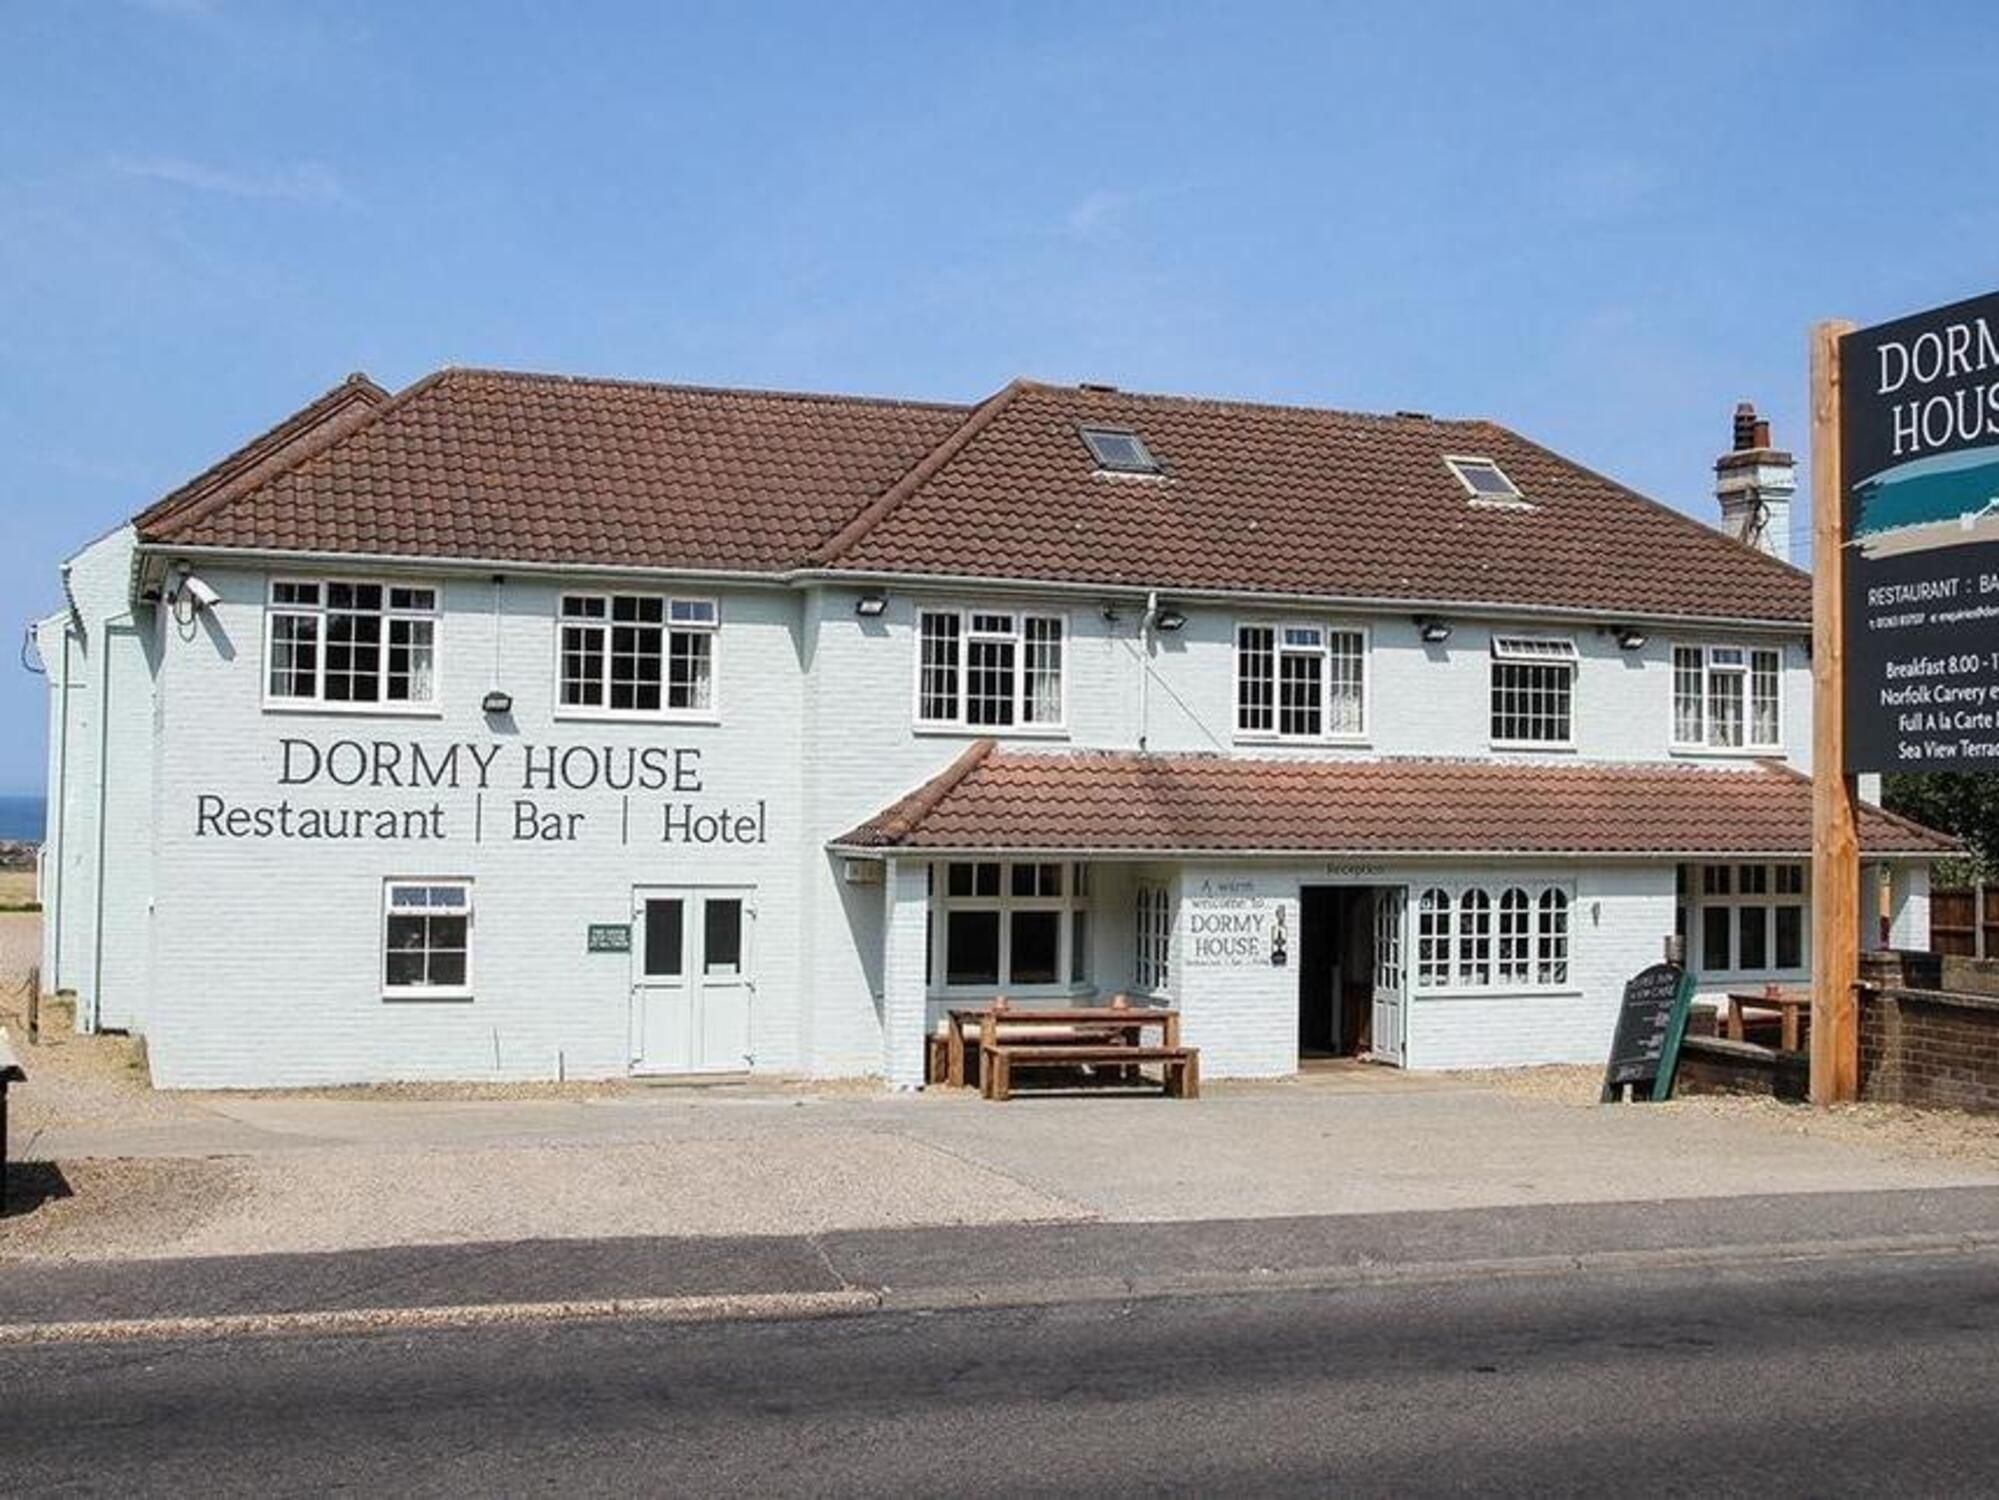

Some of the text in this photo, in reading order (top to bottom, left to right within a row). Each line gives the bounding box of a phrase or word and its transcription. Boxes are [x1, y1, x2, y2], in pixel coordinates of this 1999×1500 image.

[1868, 578, 1960, 606] RESTAURANT
[1886, 656, 1946, 679] Breakfast
[1948, 655, 1979, 674] 8.00
[1881, 685, 1931, 707] Norfolk
[1934, 684, 1986, 706] Carvery
[1899, 712, 1922, 732] Full
[1926, 713, 1936, 731] A
[1939, 711, 1951, 731] la
[1954, 711, 1992, 729] Carte
[1898, 741, 1921, 759] Sea
[1924, 741, 1957, 758] View
[278, 738, 702, 791] DORMY HOUSE
[195, 794, 766, 843] Restaurant Bar Hotel
[1191, 914, 1264, 934] DORMY
[1196, 937, 1259, 957] HOUSE
